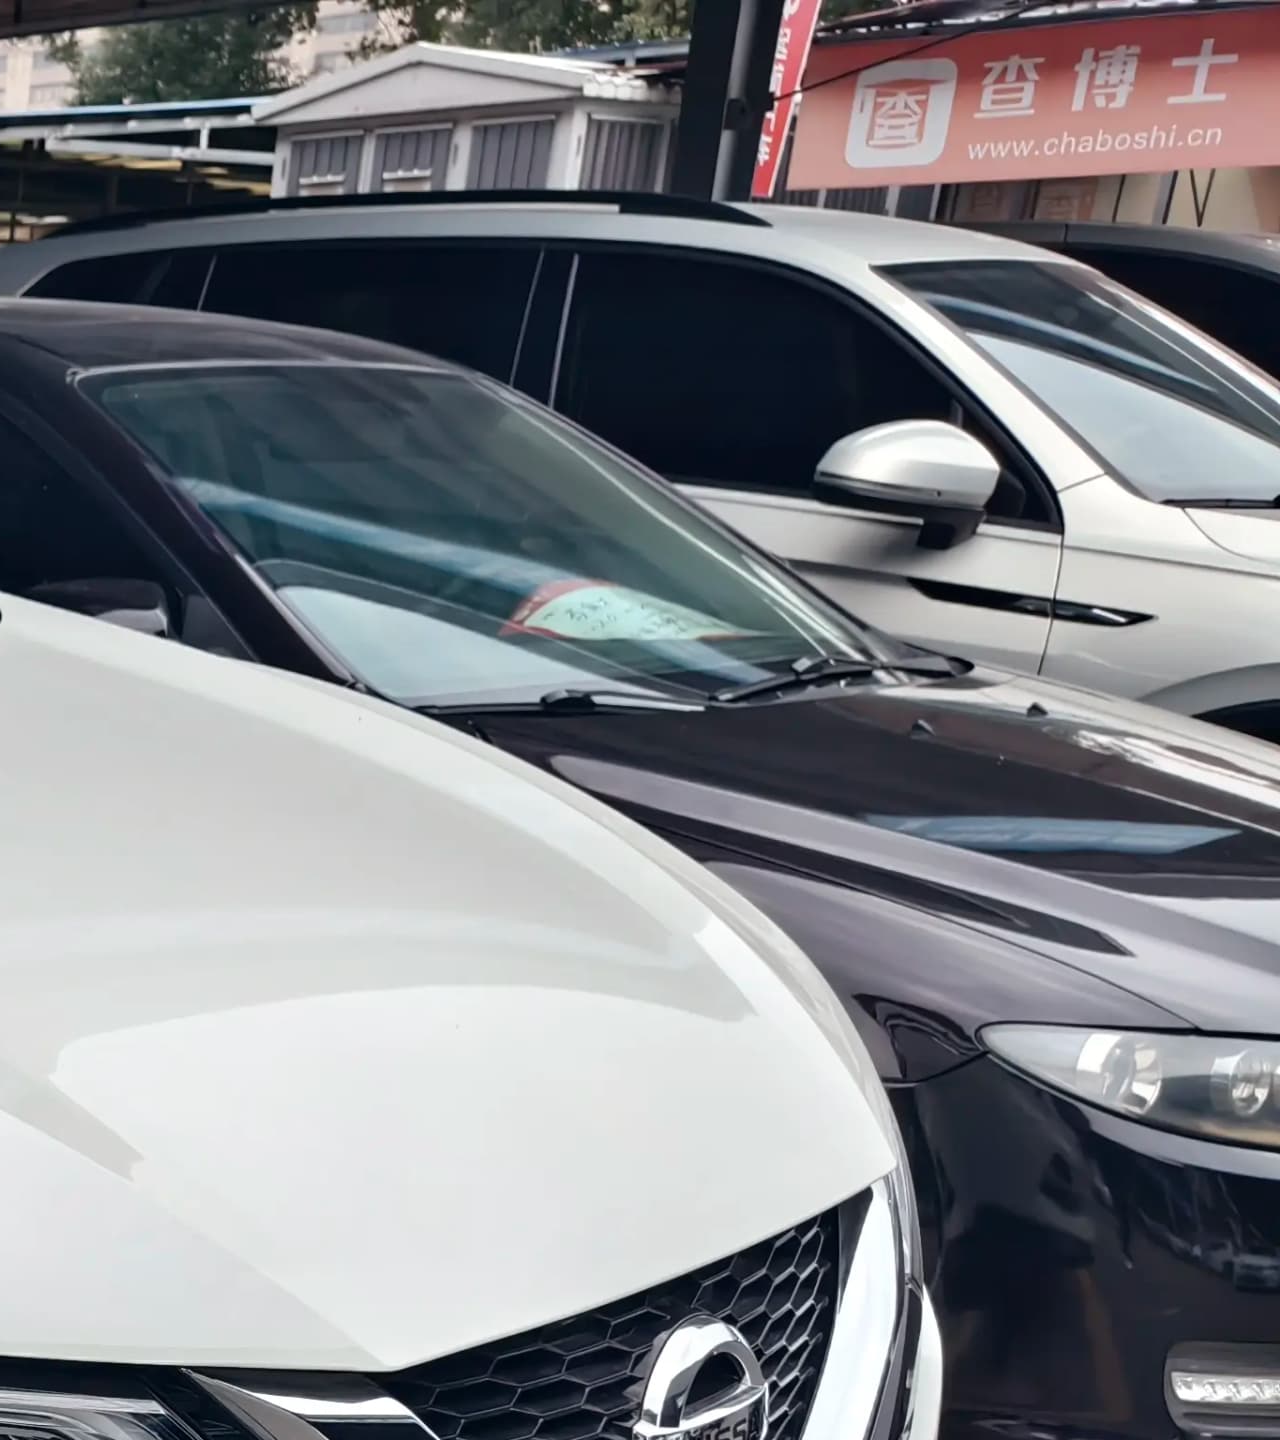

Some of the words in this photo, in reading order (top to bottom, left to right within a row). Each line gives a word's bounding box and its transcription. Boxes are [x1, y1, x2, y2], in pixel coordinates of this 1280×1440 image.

[973, 38, 1238, 118] 查博士
[967, 124, 1223, 161] www.chaboshi.cn
